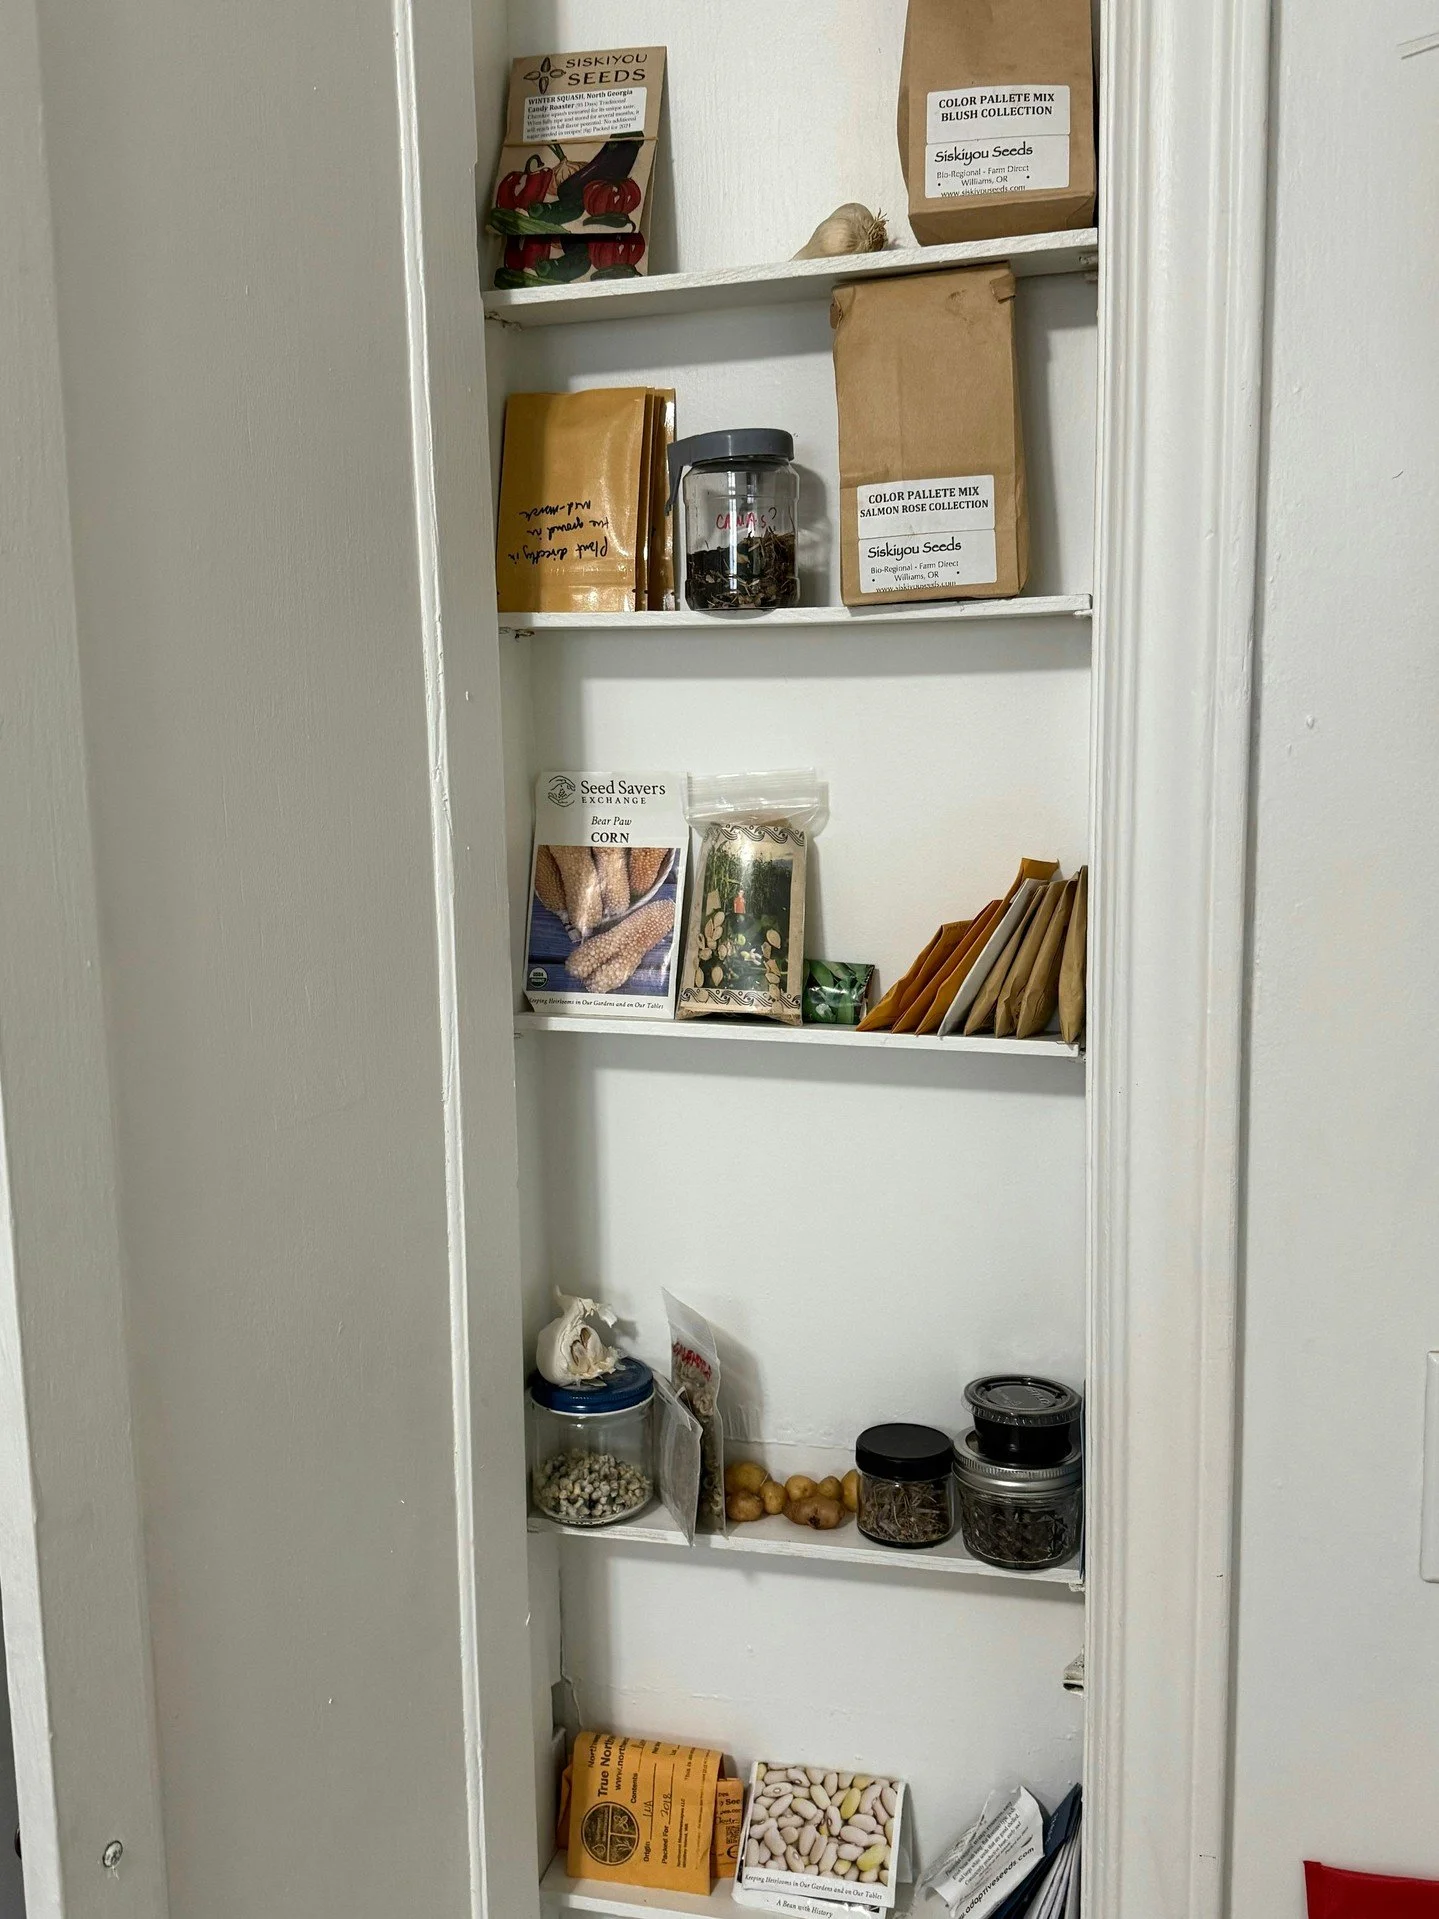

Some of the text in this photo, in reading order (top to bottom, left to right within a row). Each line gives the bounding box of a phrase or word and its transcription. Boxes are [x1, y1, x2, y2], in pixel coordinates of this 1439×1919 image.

[566, 54, 648, 69] SISKIYOU
[567, 68, 646, 87] SEEDS
[528, 97, 556, 105] WINTER
[587, 91, 606, 99] North
[939, 93, 1055, 108] COLOR PALLETE MIX
[528, 105, 548, 113] Candy
[941, 106, 1052, 122] BLUSH COLLECTION
[934, 141, 1033, 166] Siskiyou Seeds
[936, 168, 981, 179] Bio-Regional
[988, 167, 1005, 175] Farm
[1007, 165, 1029, 173] Direct
[961, 177, 994, 186] Williams,
[869, 486, 980, 504] COLOR PALLETE MIX
[860, 499, 989, 518] SALMON ROSE COLLECTION
[527, 528, 542, 540] in
[547, 516, 584, 540] ground
[508, 536, 608, 565] Plant directly in
[867, 536, 962, 561] Siskiyou Seeds
[871, 564, 913, 574] Bio-Regional
[938, 560, 959, 568] Direct
[894, 571, 939, 582] Williams, OR
[581, 780, 666, 796] Seed Savers
[582, 796, 646, 805] EXCHANGE
[591, 816, 632, 826] Bear Paw
[591, 832, 630, 843] CORN
[598, 1771, 610, 1797] True
[630, 1773, 639, 1804] Contents
[661, 1793, 672, 1817] 2018
[643, 1841, 651, 1862] Origin
[661, 1839, 669, 1864] Packed
[745, 1874, 764, 1883] Keeping
[765, 1876, 792, 1886] Heirlooms
[811, 1883, 833, 1892] Gardens
[834, 1886, 844, 1894] and
[865, 1891, 883, 1900] Tables
[783, 1900, 797, 1909] Bean
[798, 1904, 811, 1913] with
[811, 1906, 834, 1918] History
